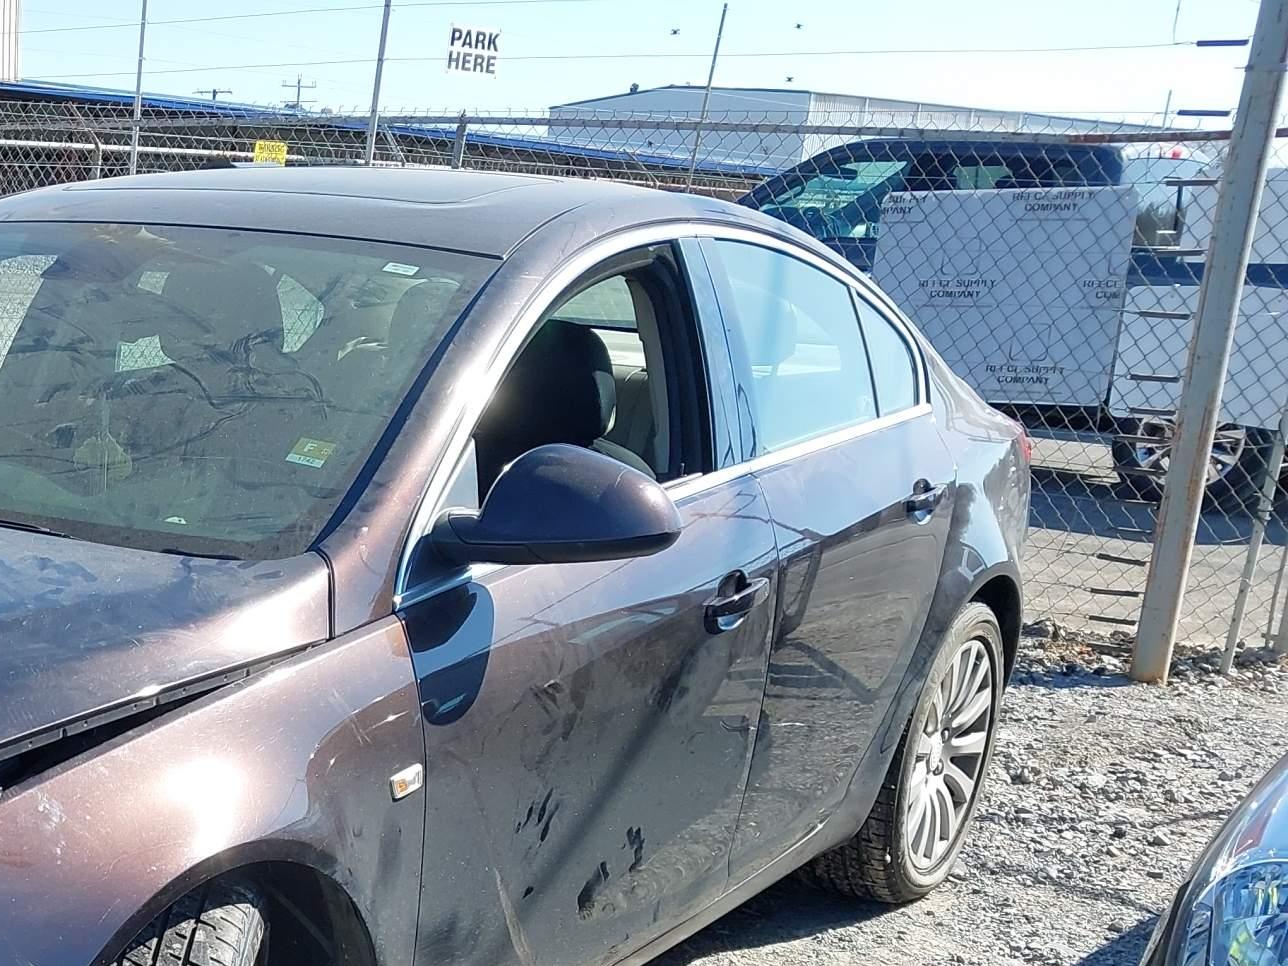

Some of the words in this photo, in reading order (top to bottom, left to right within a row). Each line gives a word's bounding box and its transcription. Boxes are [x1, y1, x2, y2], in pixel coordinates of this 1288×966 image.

[449, 27, 500, 52] PARK
[447, 50, 497, 74] HERE
[1024, 202, 1079, 212] COMPANY
[956, 279, 996, 289] SUPPLY
[930, 290, 980, 298] COMPANY
[997, 375, 1049, 385] COMPANY
